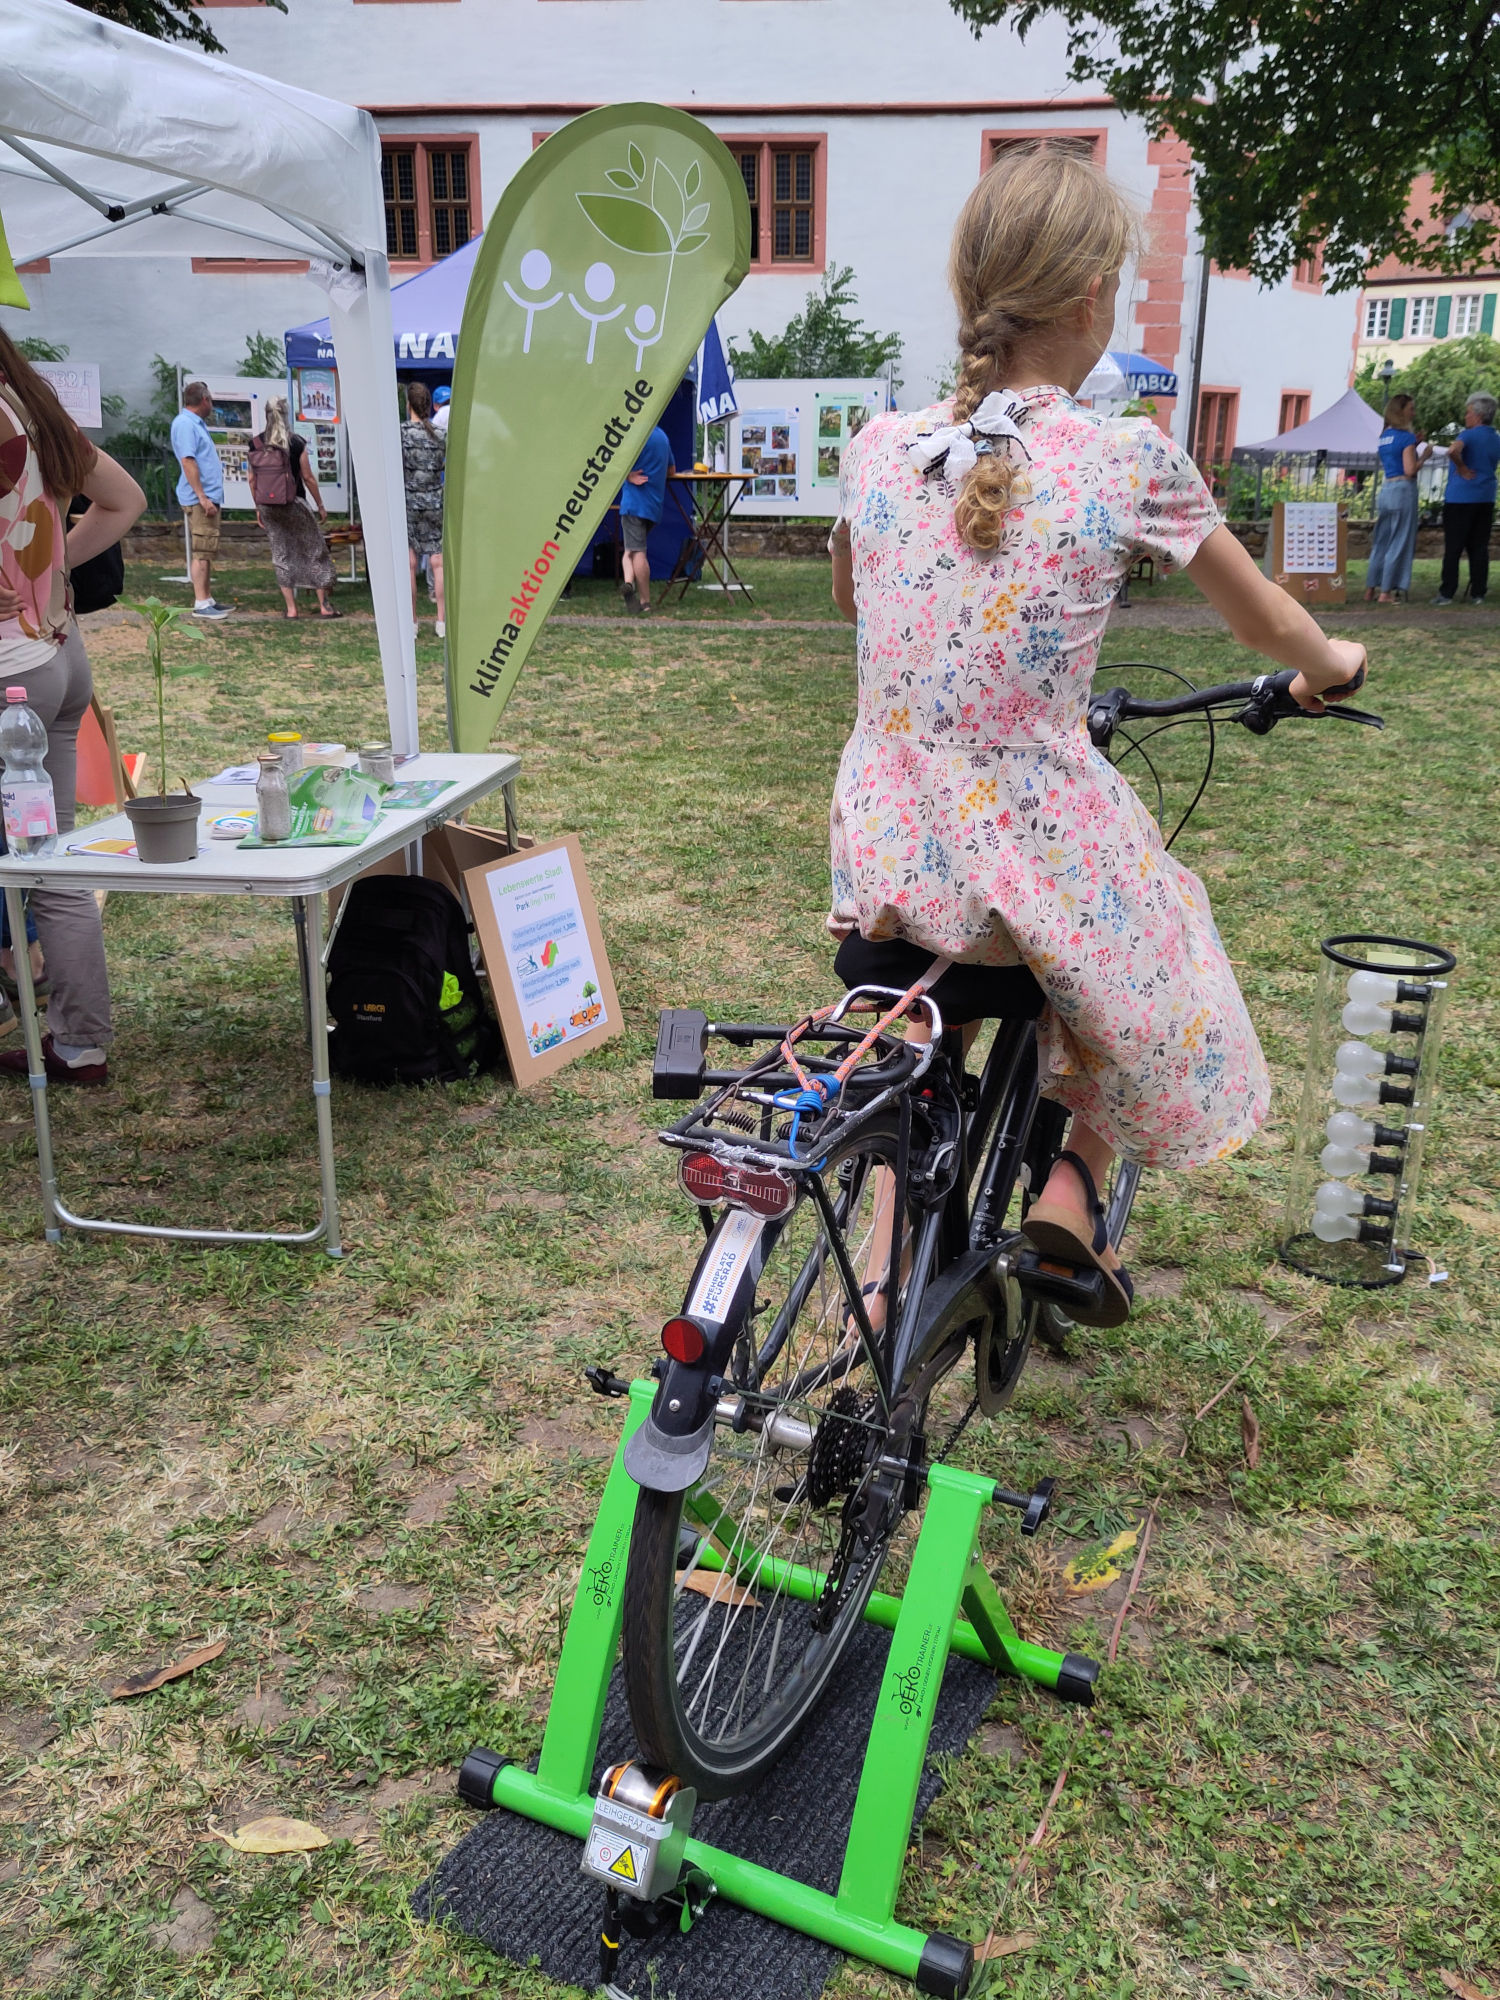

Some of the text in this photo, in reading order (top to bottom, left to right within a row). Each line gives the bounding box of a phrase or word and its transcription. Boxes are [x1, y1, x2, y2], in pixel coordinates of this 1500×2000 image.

[317, 349, 335, 359] NA
[400, 333, 455, 358] NA
[1127, 375, 1173, 391] NABU
[701, 392, 736, 423] NA
[469, 379, 653, 697] klimaaktion-neustadt.de
[497, 872, 543, 896] Lebenswerte
[544, 866, 562, 879] Stadt
